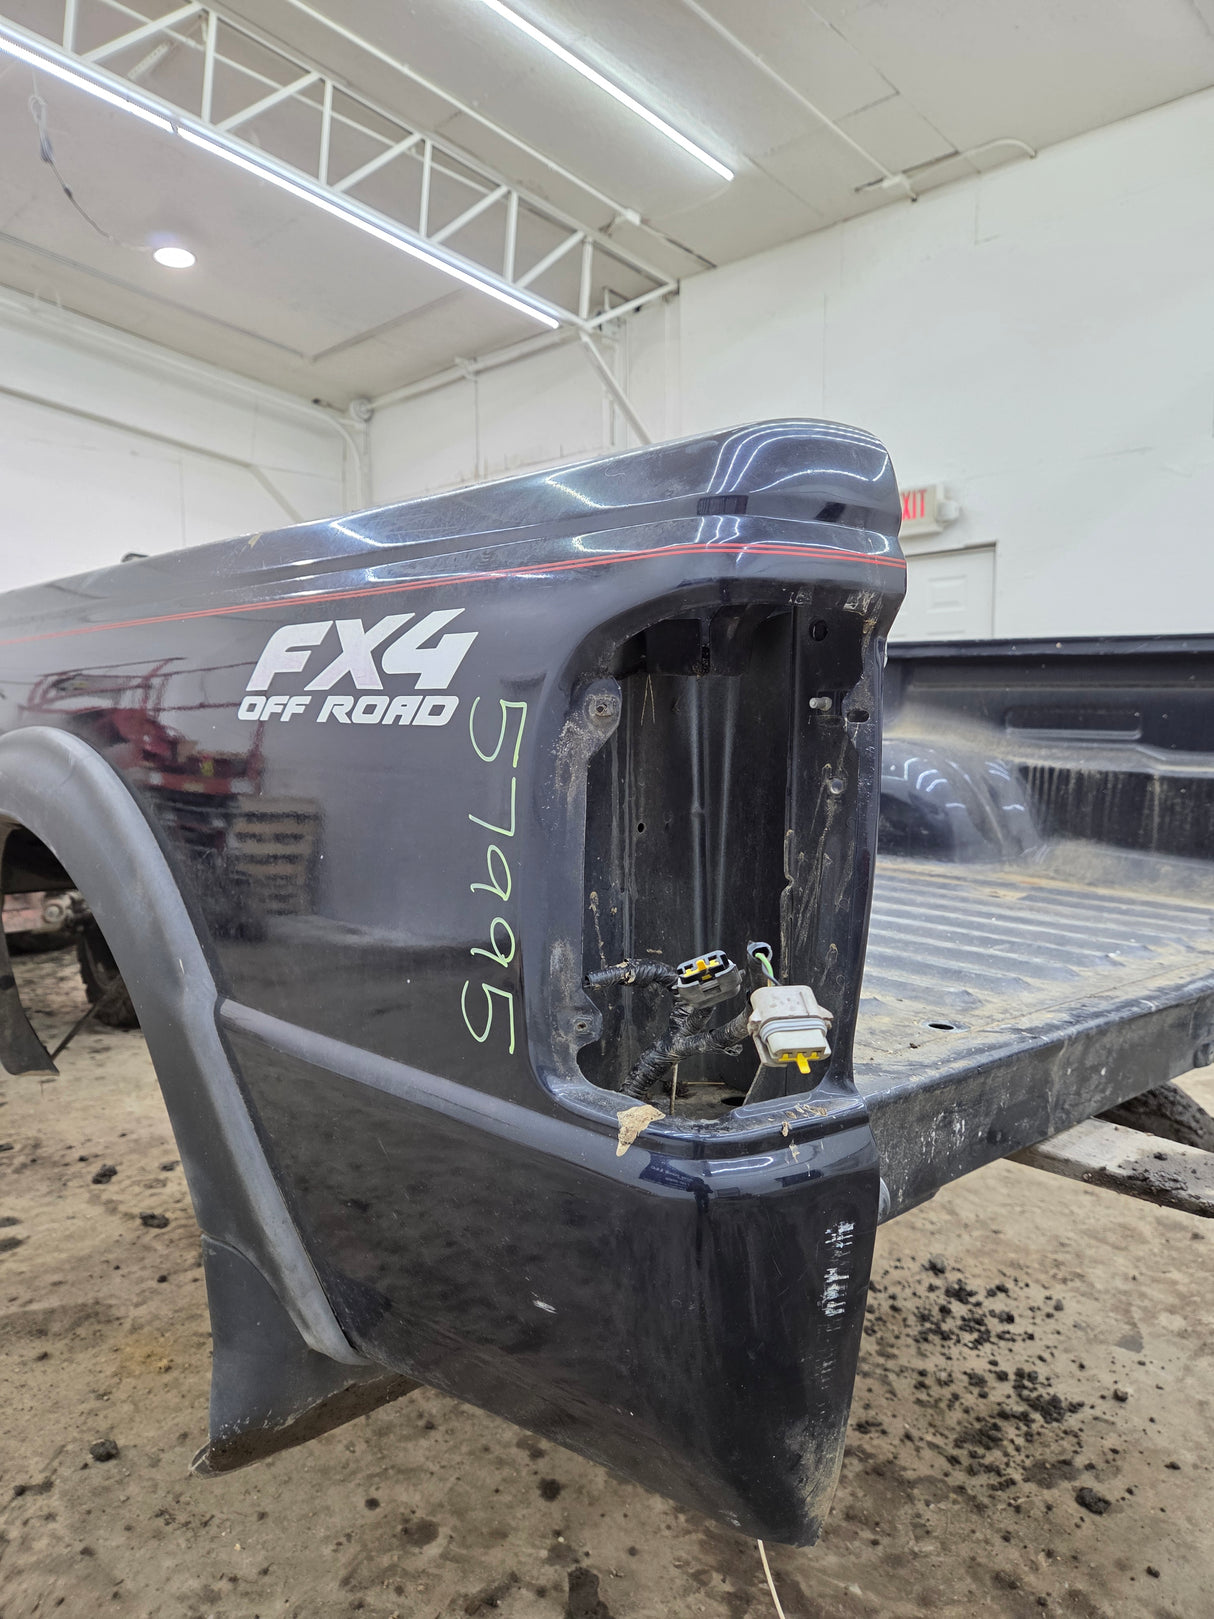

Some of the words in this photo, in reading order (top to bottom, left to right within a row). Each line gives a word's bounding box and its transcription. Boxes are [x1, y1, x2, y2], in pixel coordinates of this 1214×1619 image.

[901, 488, 928, 520] XIT
[245, 608, 479, 692] FX4
[237, 695, 310, 722] OFF
[316, 695, 460, 727] ROAD
[461, 696, 528, 1054] 57995
